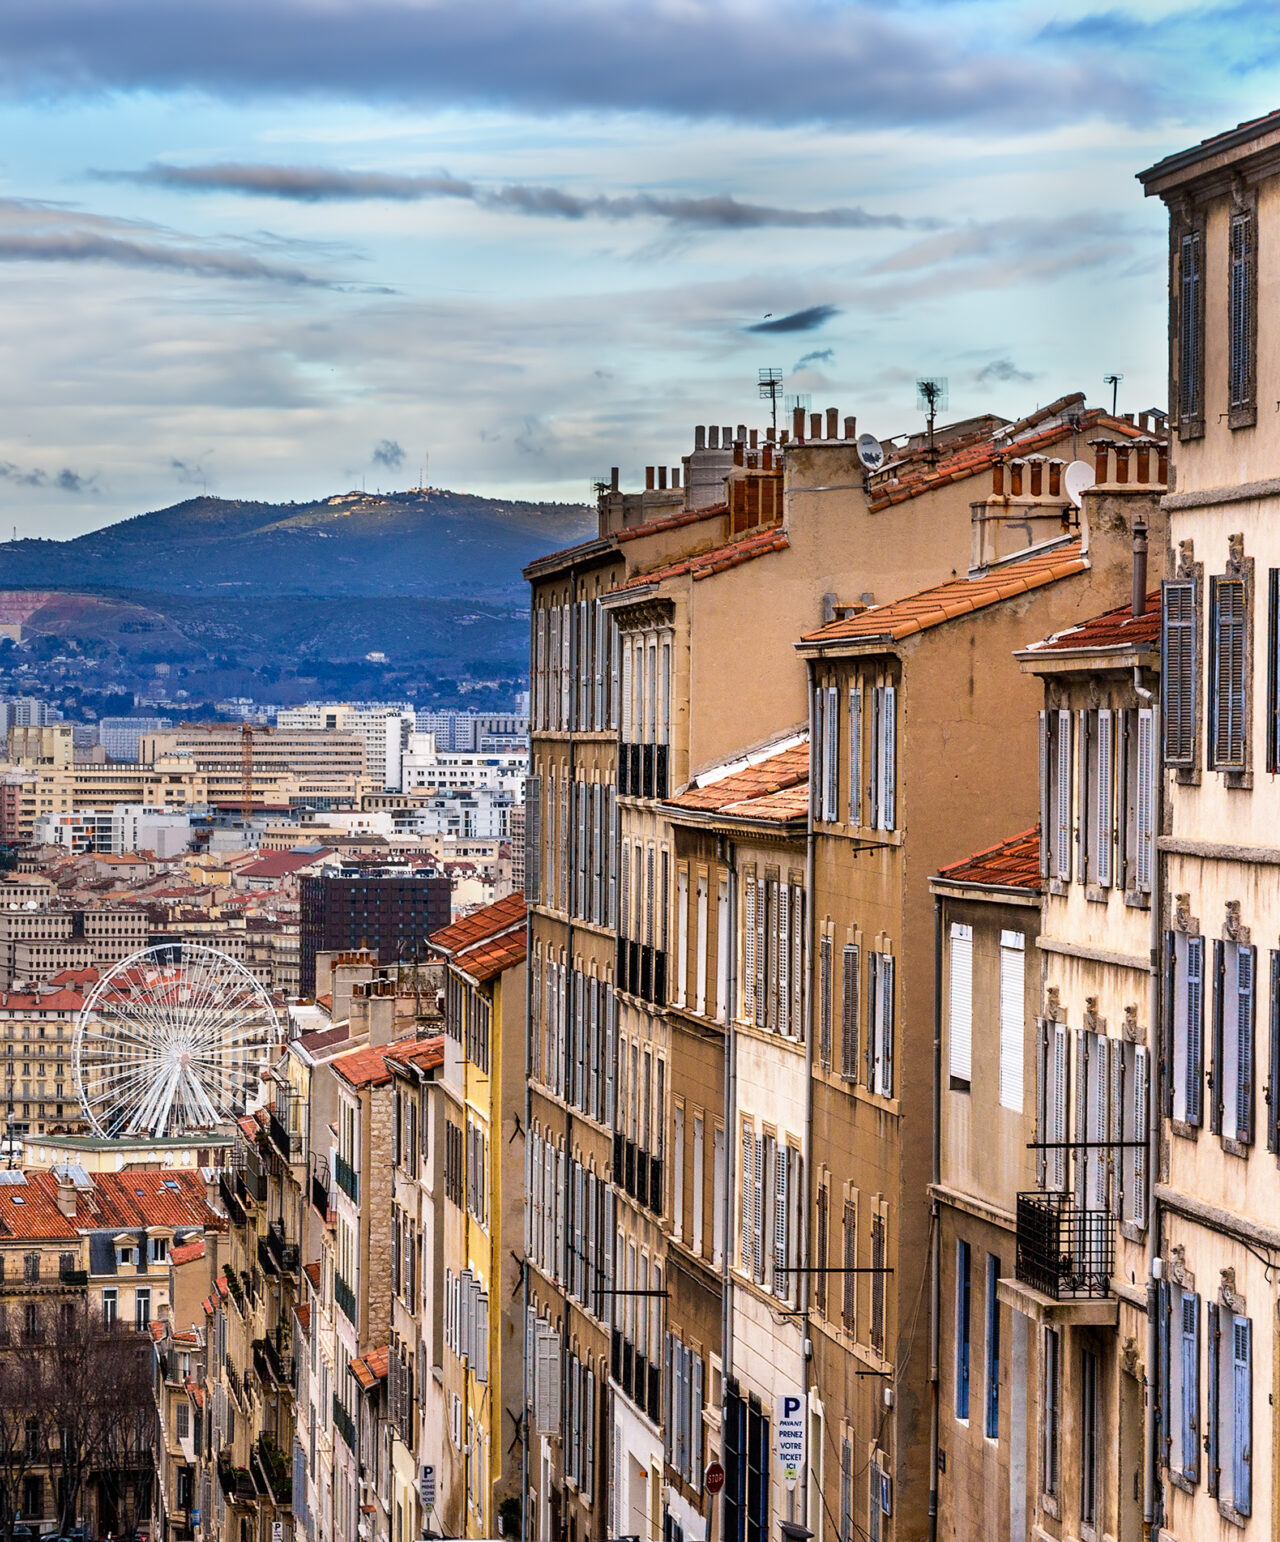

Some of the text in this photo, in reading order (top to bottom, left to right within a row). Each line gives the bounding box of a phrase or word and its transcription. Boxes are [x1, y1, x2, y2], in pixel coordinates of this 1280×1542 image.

[784, 1397, 800, 1418] P
[779, 1430, 802, 1438] PRENEZ
[780, 1442, 802, 1450] VOTRE
[780, 1453, 802, 1461] TICKET
[424, 1466, 433, 1478] P
[708, 1473, 722, 1484] STOP
